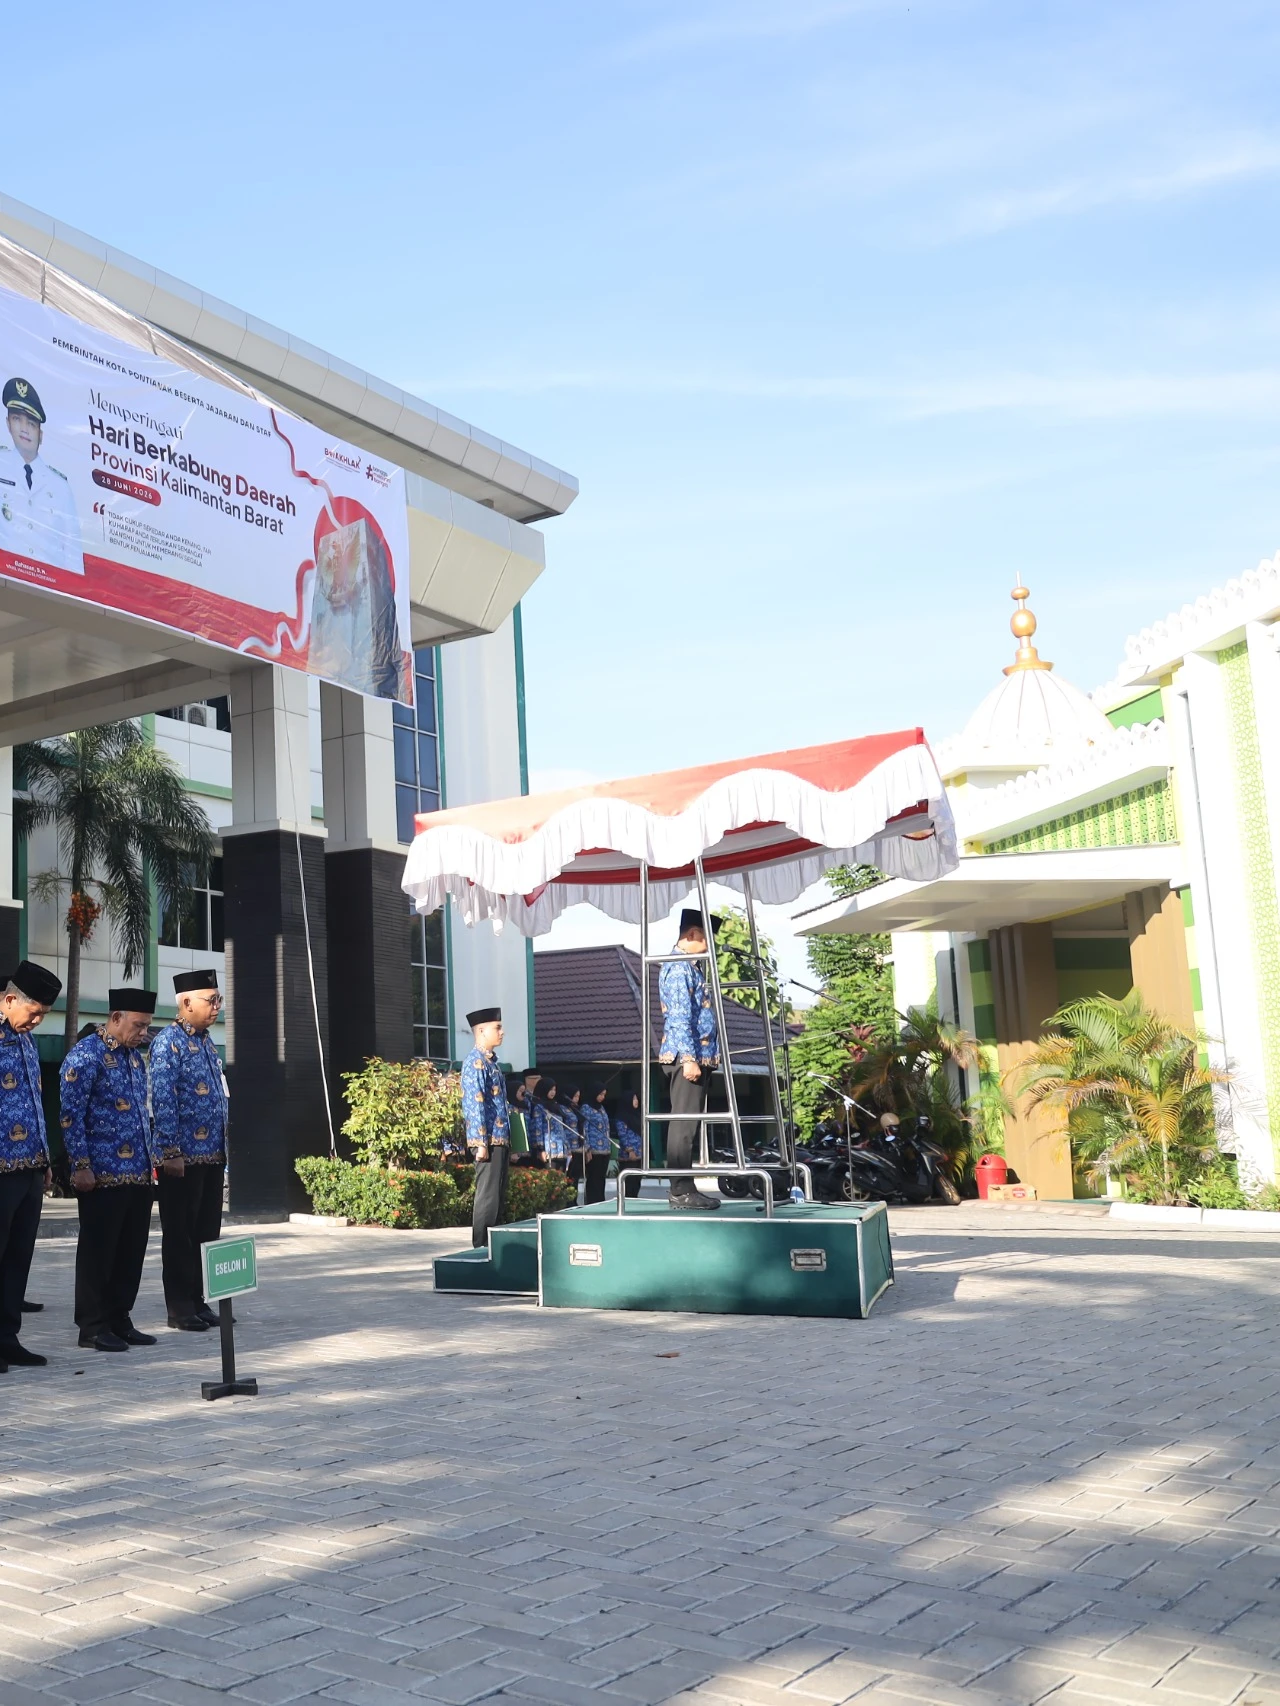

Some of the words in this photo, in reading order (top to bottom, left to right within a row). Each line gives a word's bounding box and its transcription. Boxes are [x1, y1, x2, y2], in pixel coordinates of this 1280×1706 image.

[52, 336, 105, 366] PEMERINTAH
[105, 360, 128, 375] KOTA
[128, 369, 173, 395] PONTIANAK
[174, 388, 205, 408] BESERTA
[206, 403, 239, 424] JAJARAN
[239, 418, 255, 431] DAN
[87, 388, 183, 440] Memperingati
[88, 414, 130, 450] Hari
[133, 431, 231, 496] Berkabung
[235, 475, 297, 517] Daerah
[90, 442, 158, 485] Provinsi
[161, 467, 241, 521] Kalimantan
[244, 505, 285, 536] Barat
[101, 475, 112, 484] 28
[114, 480, 132, 492] JUNI
[133, 486, 154, 500] 2026
[108, 511, 124, 522] TIDAK
[124, 517, 143, 528] CUKUP
[215, 1258, 241, 1276] ESELON
[242, 1257, 247, 1270] II
